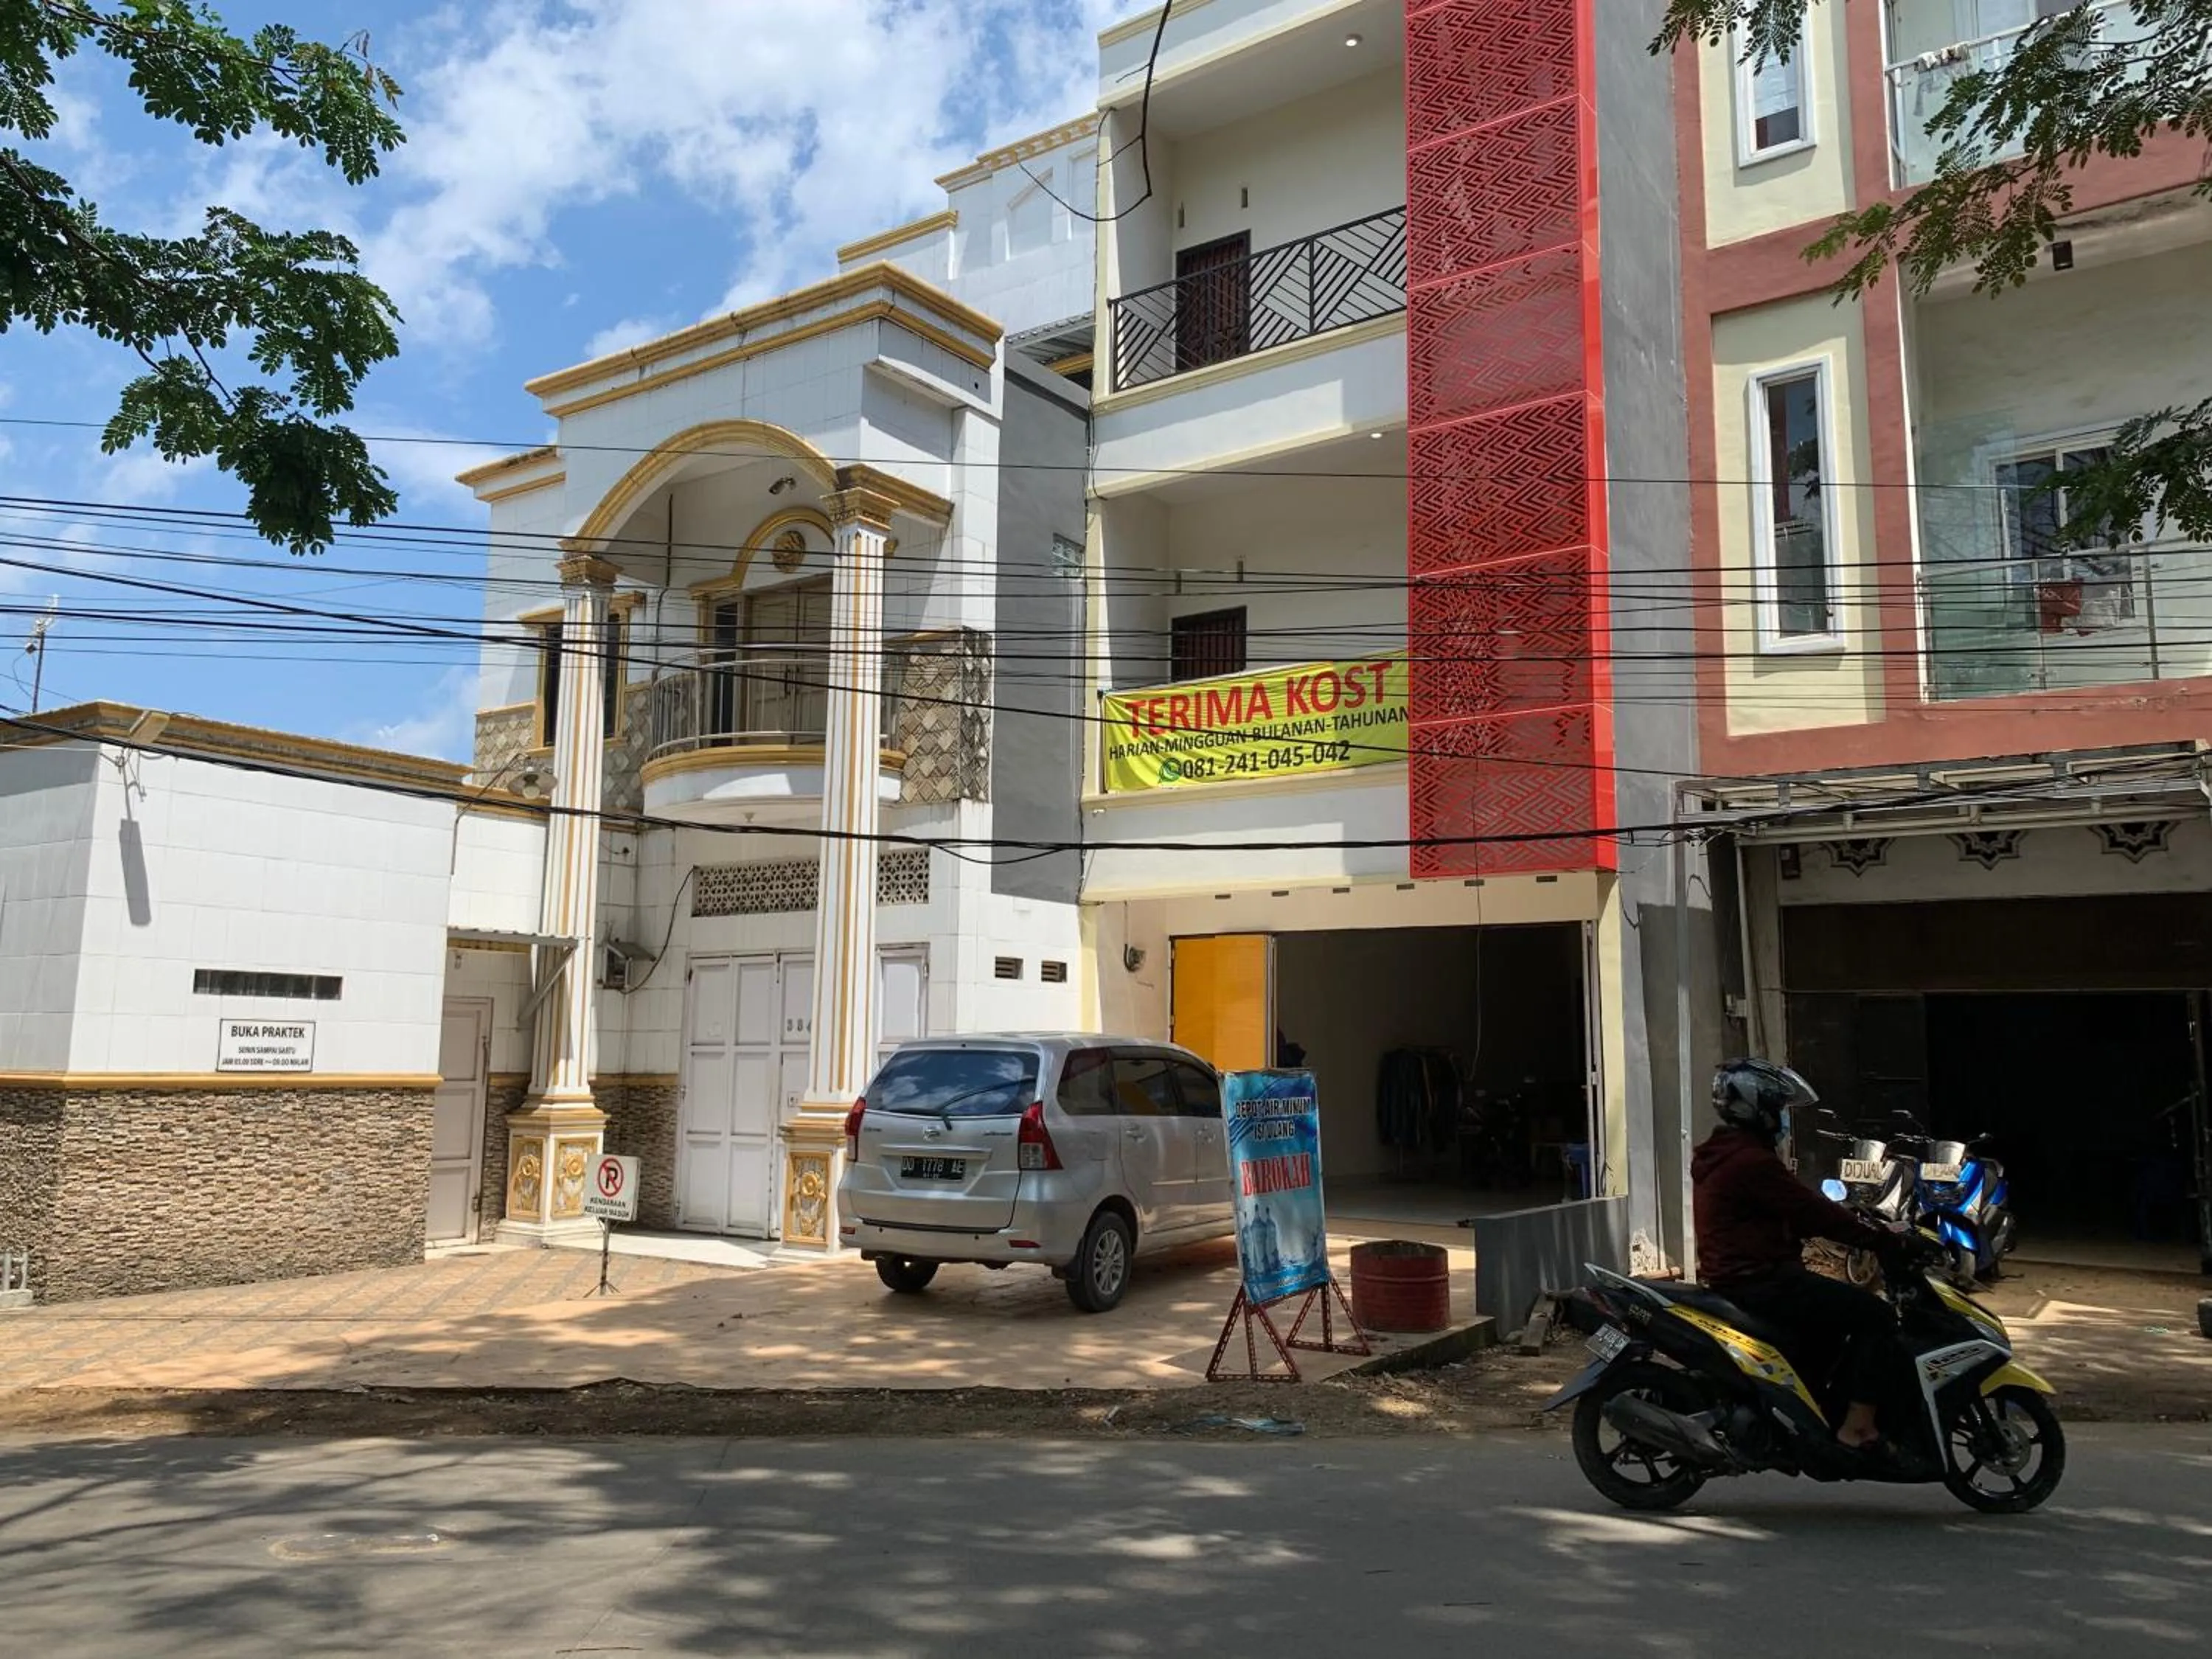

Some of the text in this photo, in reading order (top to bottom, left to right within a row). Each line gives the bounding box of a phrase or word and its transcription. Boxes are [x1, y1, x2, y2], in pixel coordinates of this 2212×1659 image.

[1124, 661, 1394, 739] TERIMA KOST
[1183, 740, 1350, 779] 081-241-045-042
[231, 1026, 305, 1038] BUKA PRAKTEK
[1235, 1099, 1262, 1119] DEPOT
[1264, 1099, 1281, 1117] AIR
[1241, 1153, 1310, 1197] BAROKAH
